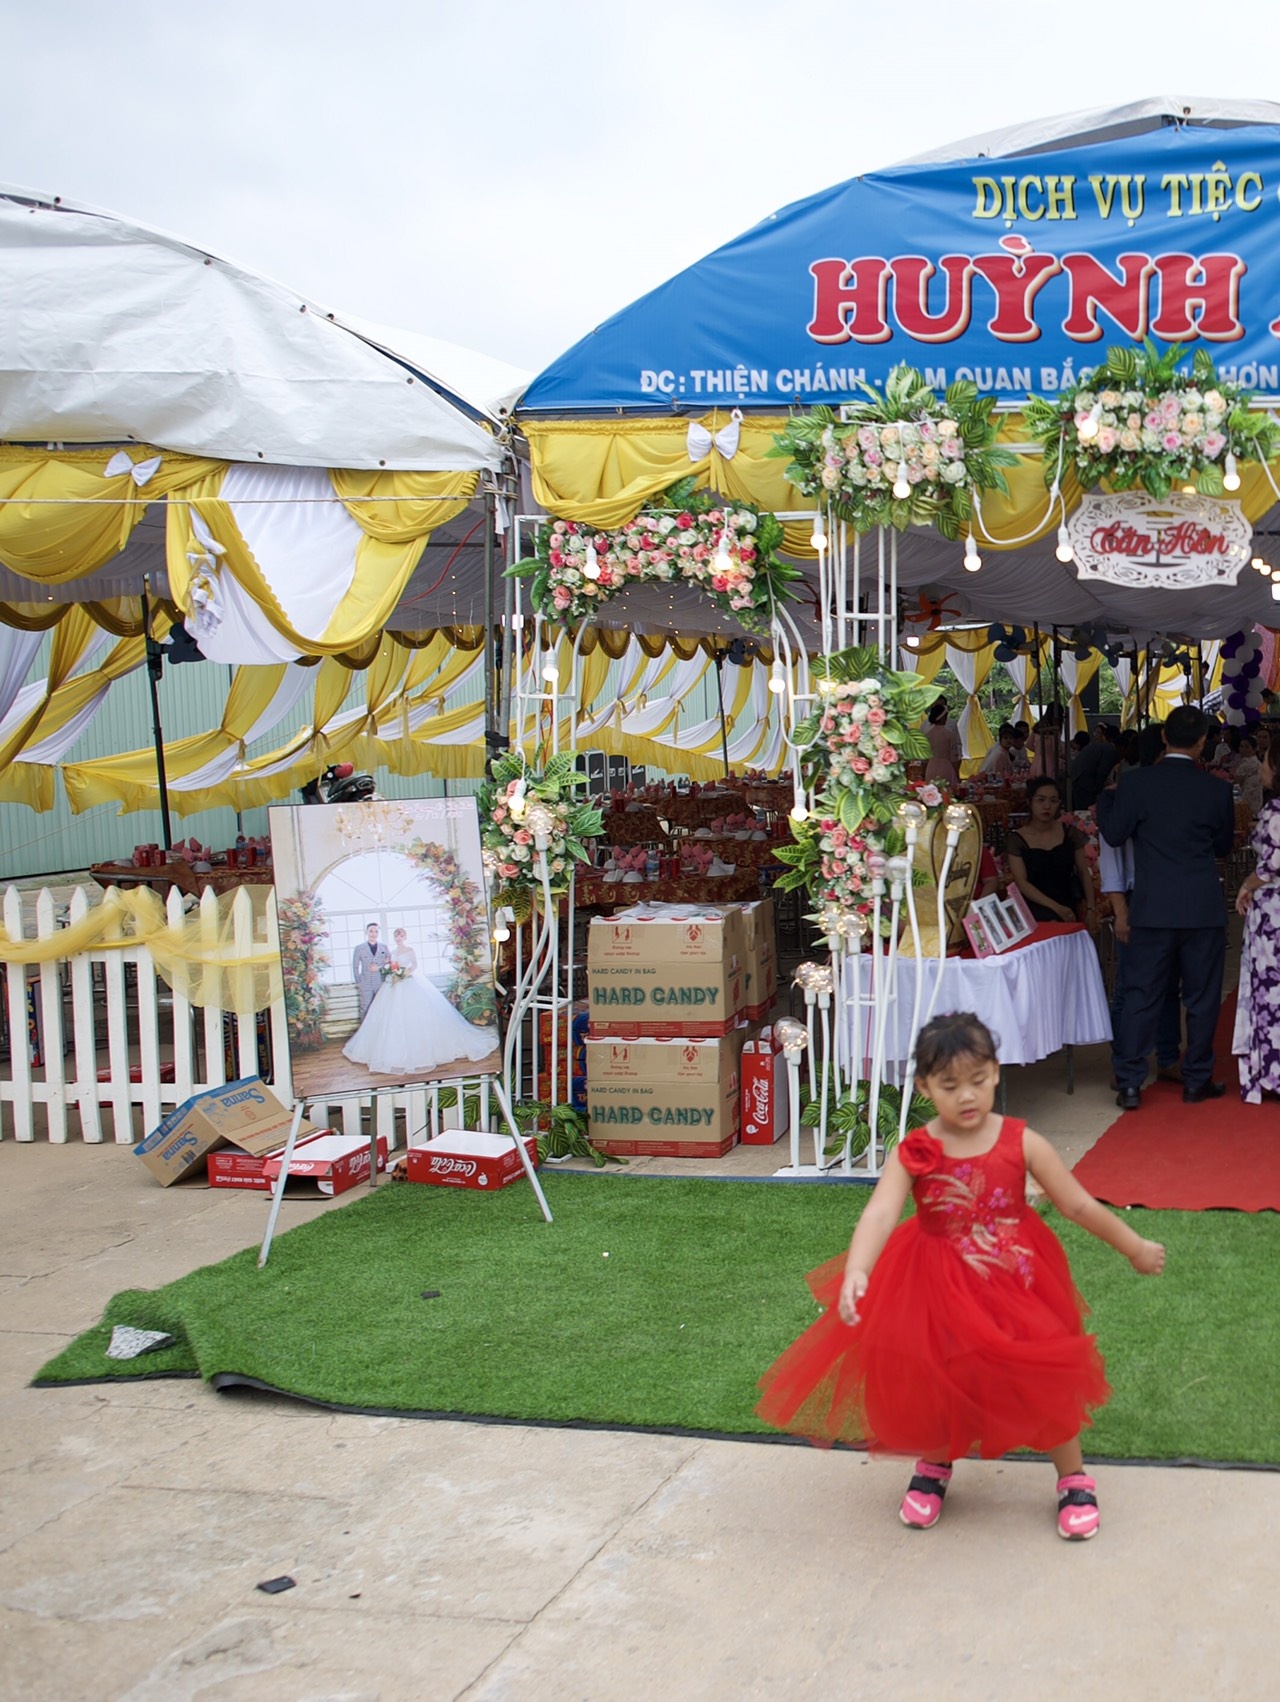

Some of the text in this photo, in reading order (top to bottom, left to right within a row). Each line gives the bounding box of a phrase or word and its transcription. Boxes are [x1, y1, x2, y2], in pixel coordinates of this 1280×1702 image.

[972, 175, 1077, 229] DỊCH
[1088, 175, 1146, 229] VỤ
[1161, 160, 1263, 222] TIỆC
[690, 364, 768, 399] THIỆN
[776, 362, 866, 393] CHÁNH
[592, 967, 656, 975] HARD CANDY IN BAG
[593, 987, 719, 1006] HARD CANDY
[222, 1087, 266, 1108] Sanna
[609, 1087, 630, 1095] CANDY
[592, 1105, 714, 1126] HARD CANDY
[162, 1131, 198, 1161] Sanna
[287, 1162, 314, 1173] Coca-Co
[428, 1157, 477, 1177] Coca-Cola
